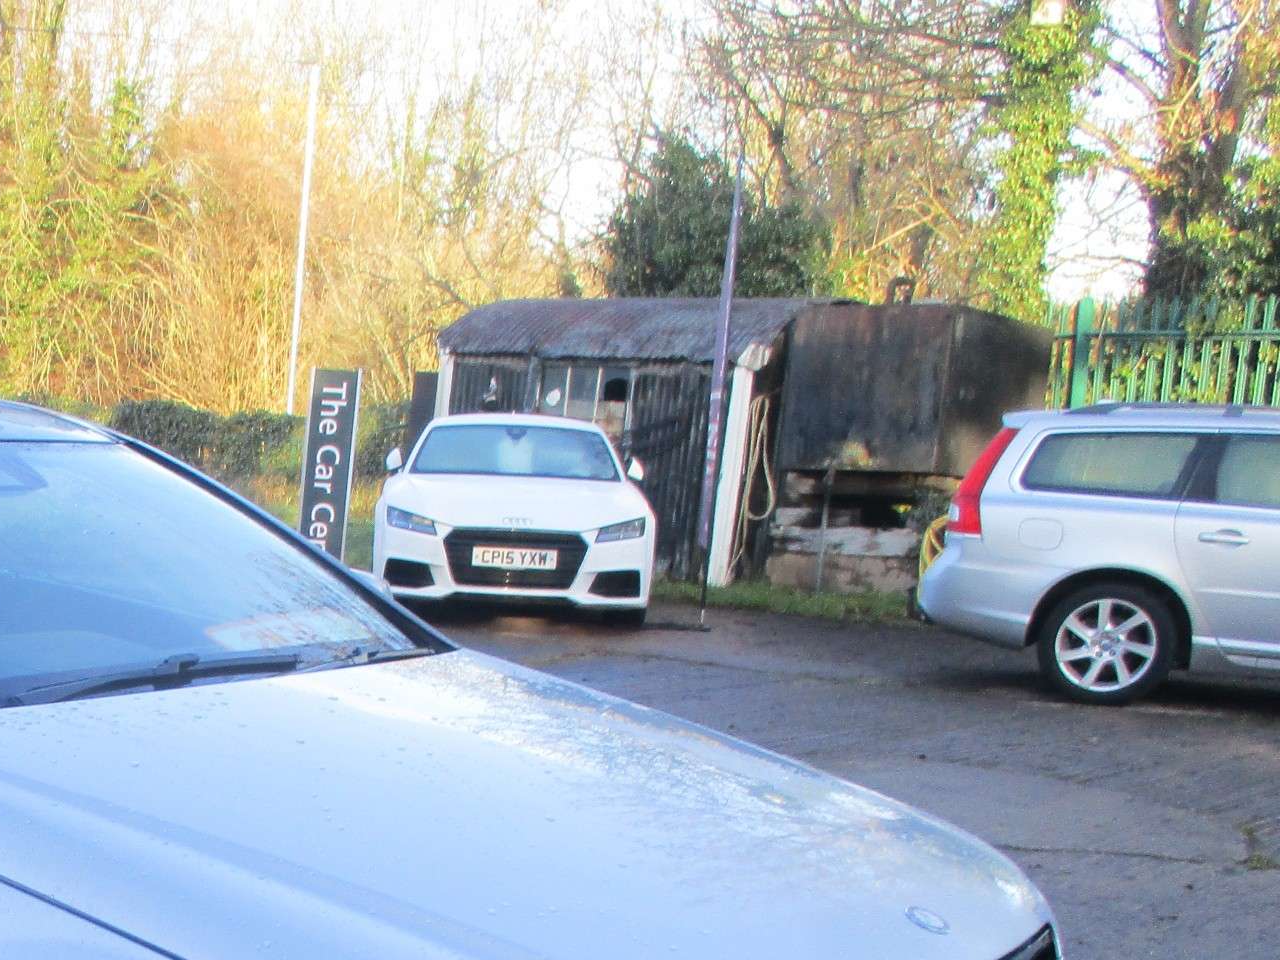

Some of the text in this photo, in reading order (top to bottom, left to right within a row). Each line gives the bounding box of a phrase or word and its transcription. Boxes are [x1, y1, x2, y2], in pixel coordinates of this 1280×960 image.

[319, 382, 348, 436] The
[313, 443, 341, 495] Car
[480, 549, 515, 565] CP15
